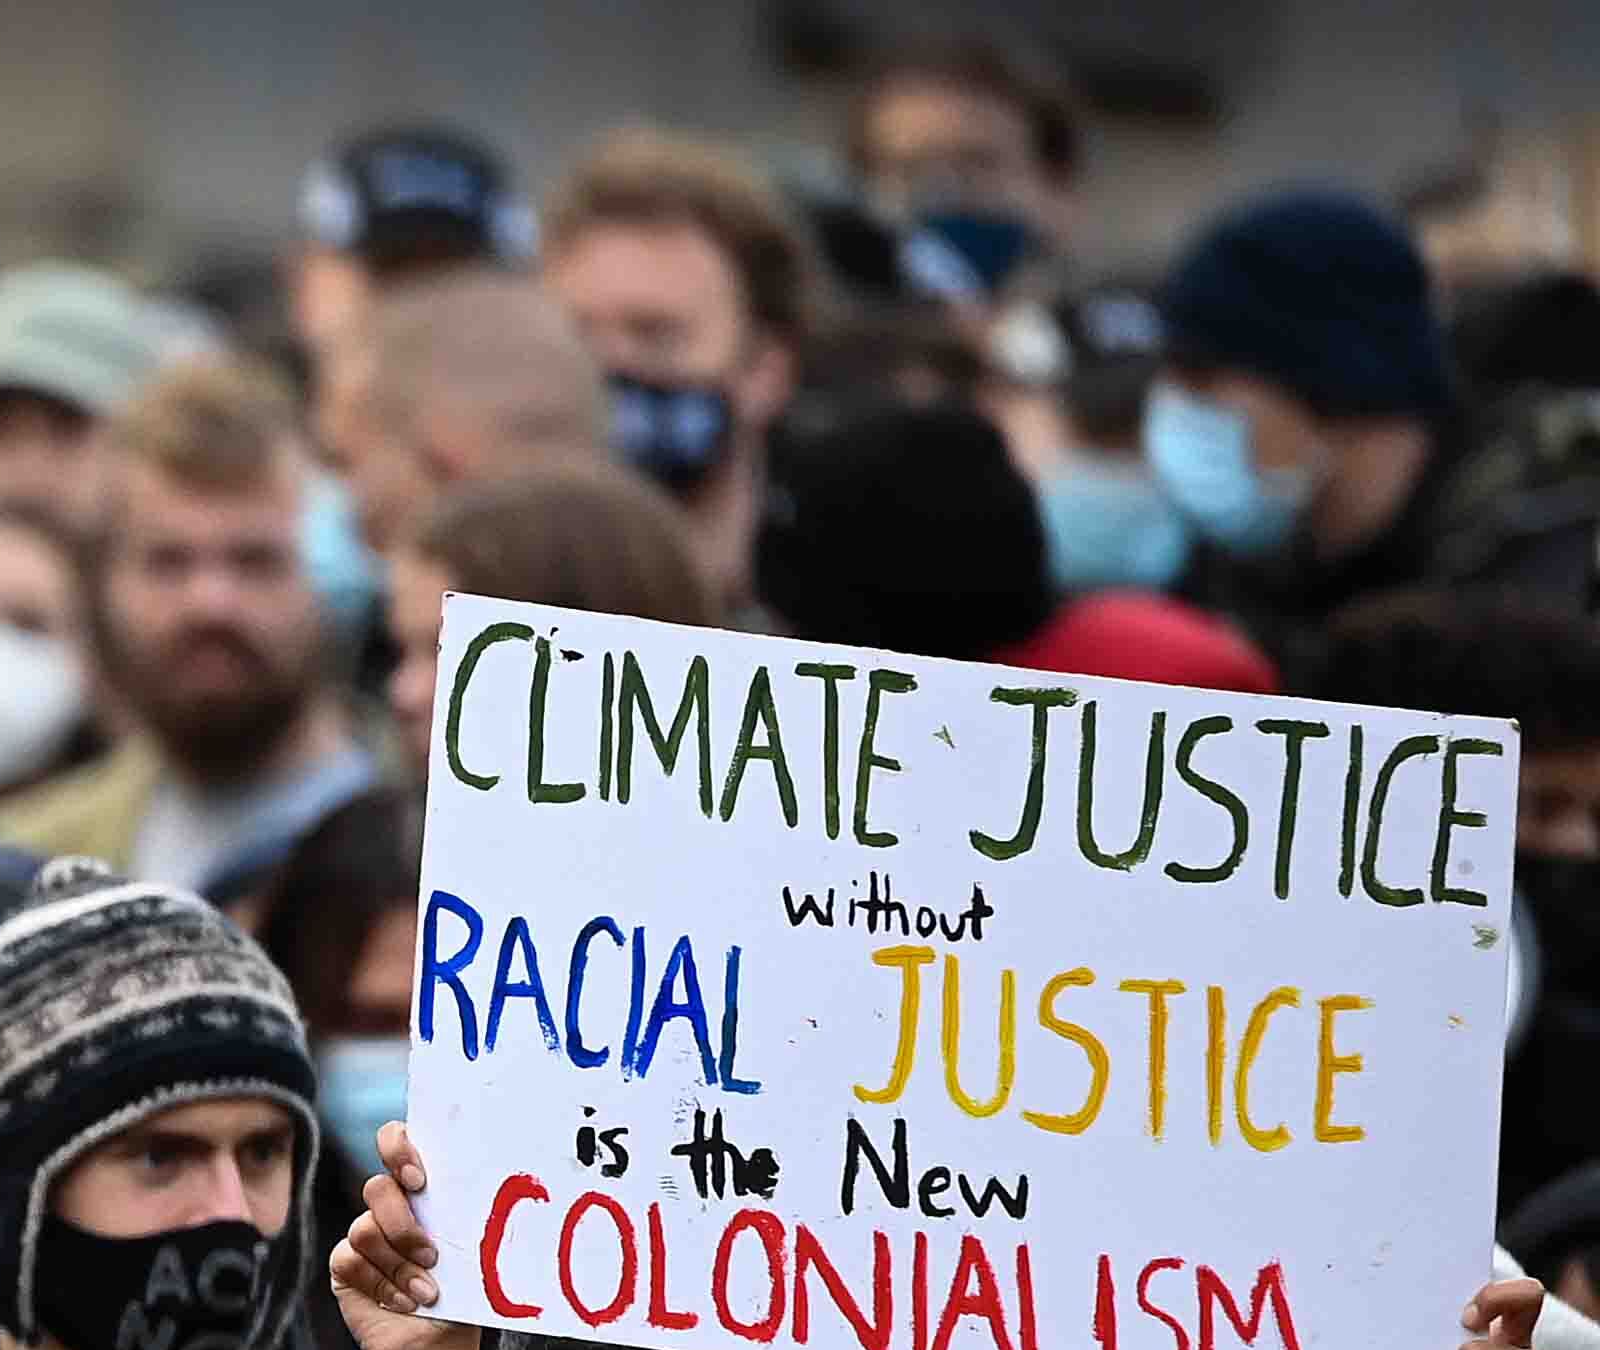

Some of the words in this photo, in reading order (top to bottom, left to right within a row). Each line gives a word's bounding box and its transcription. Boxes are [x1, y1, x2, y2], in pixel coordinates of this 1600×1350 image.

[445, 621, 918, 848] CLIMATE
[968, 687, 1505, 908] JUSTICE
[781, 871, 996, 943] without
[418, 889, 766, 1097] RACIAL
[853, 944, 1375, 1153] JUSTICE
[576, 1105, 630, 1178] is
[670, 1107, 781, 1202] the
[840, 1112, 1030, 1220] New
